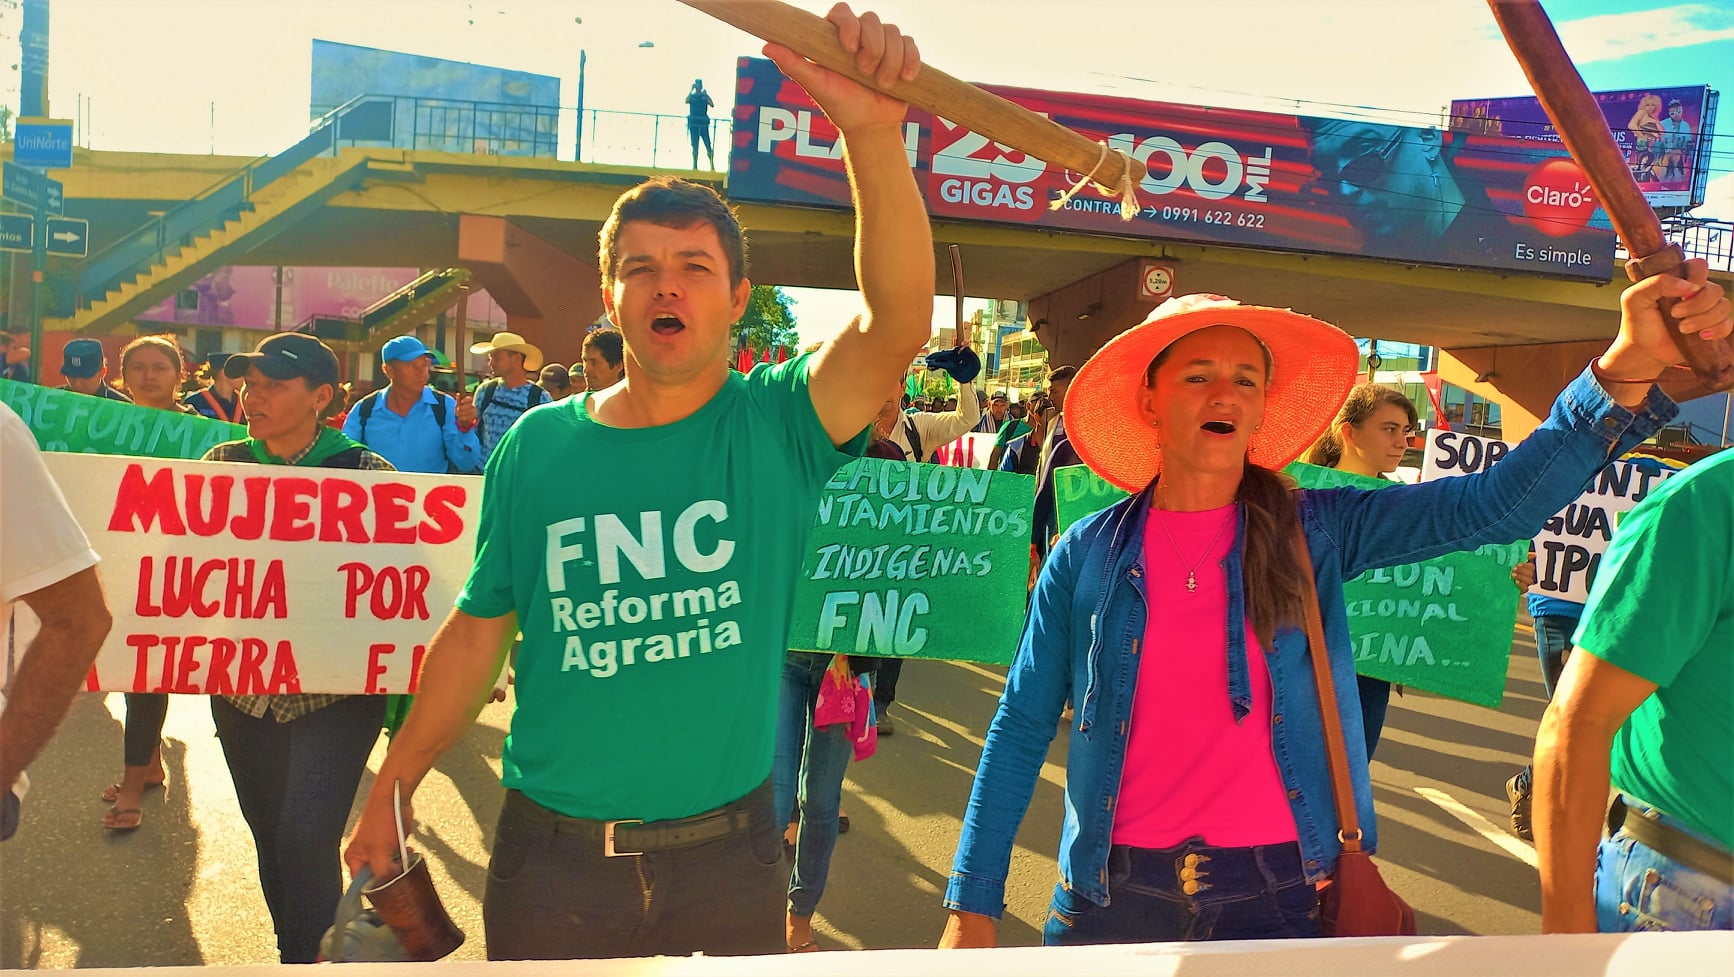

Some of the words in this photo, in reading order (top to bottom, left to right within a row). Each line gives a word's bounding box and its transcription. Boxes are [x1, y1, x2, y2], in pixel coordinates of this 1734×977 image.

[18, 137, 68, 151] UniNorte
[940, 178, 1034, 210] GIGAS
[1244, 147, 1272, 203] MIL
[1527, 184, 1583, 208] Claro
[1163, 206, 1199, 223] 0991
[1204, 210, 1232, 225] 622
[1237, 213, 1265, 229] 622
[1515, 243, 1534, 260] Es
[1539, 246, 1592, 266] simple
[327, 272, 399, 294] Palette
[108, 463, 467, 545] MUJERES
[546, 500, 736, 593] FNC
[135, 556, 289, 620] LUCHA
[337, 562, 431, 621] POR
[551, 580, 742, 633] Reforma
[561, 619, 743, 678] Agraria
[816, 589, 930, 656] FNC
[127, 634, 302, 695] TIERRA
